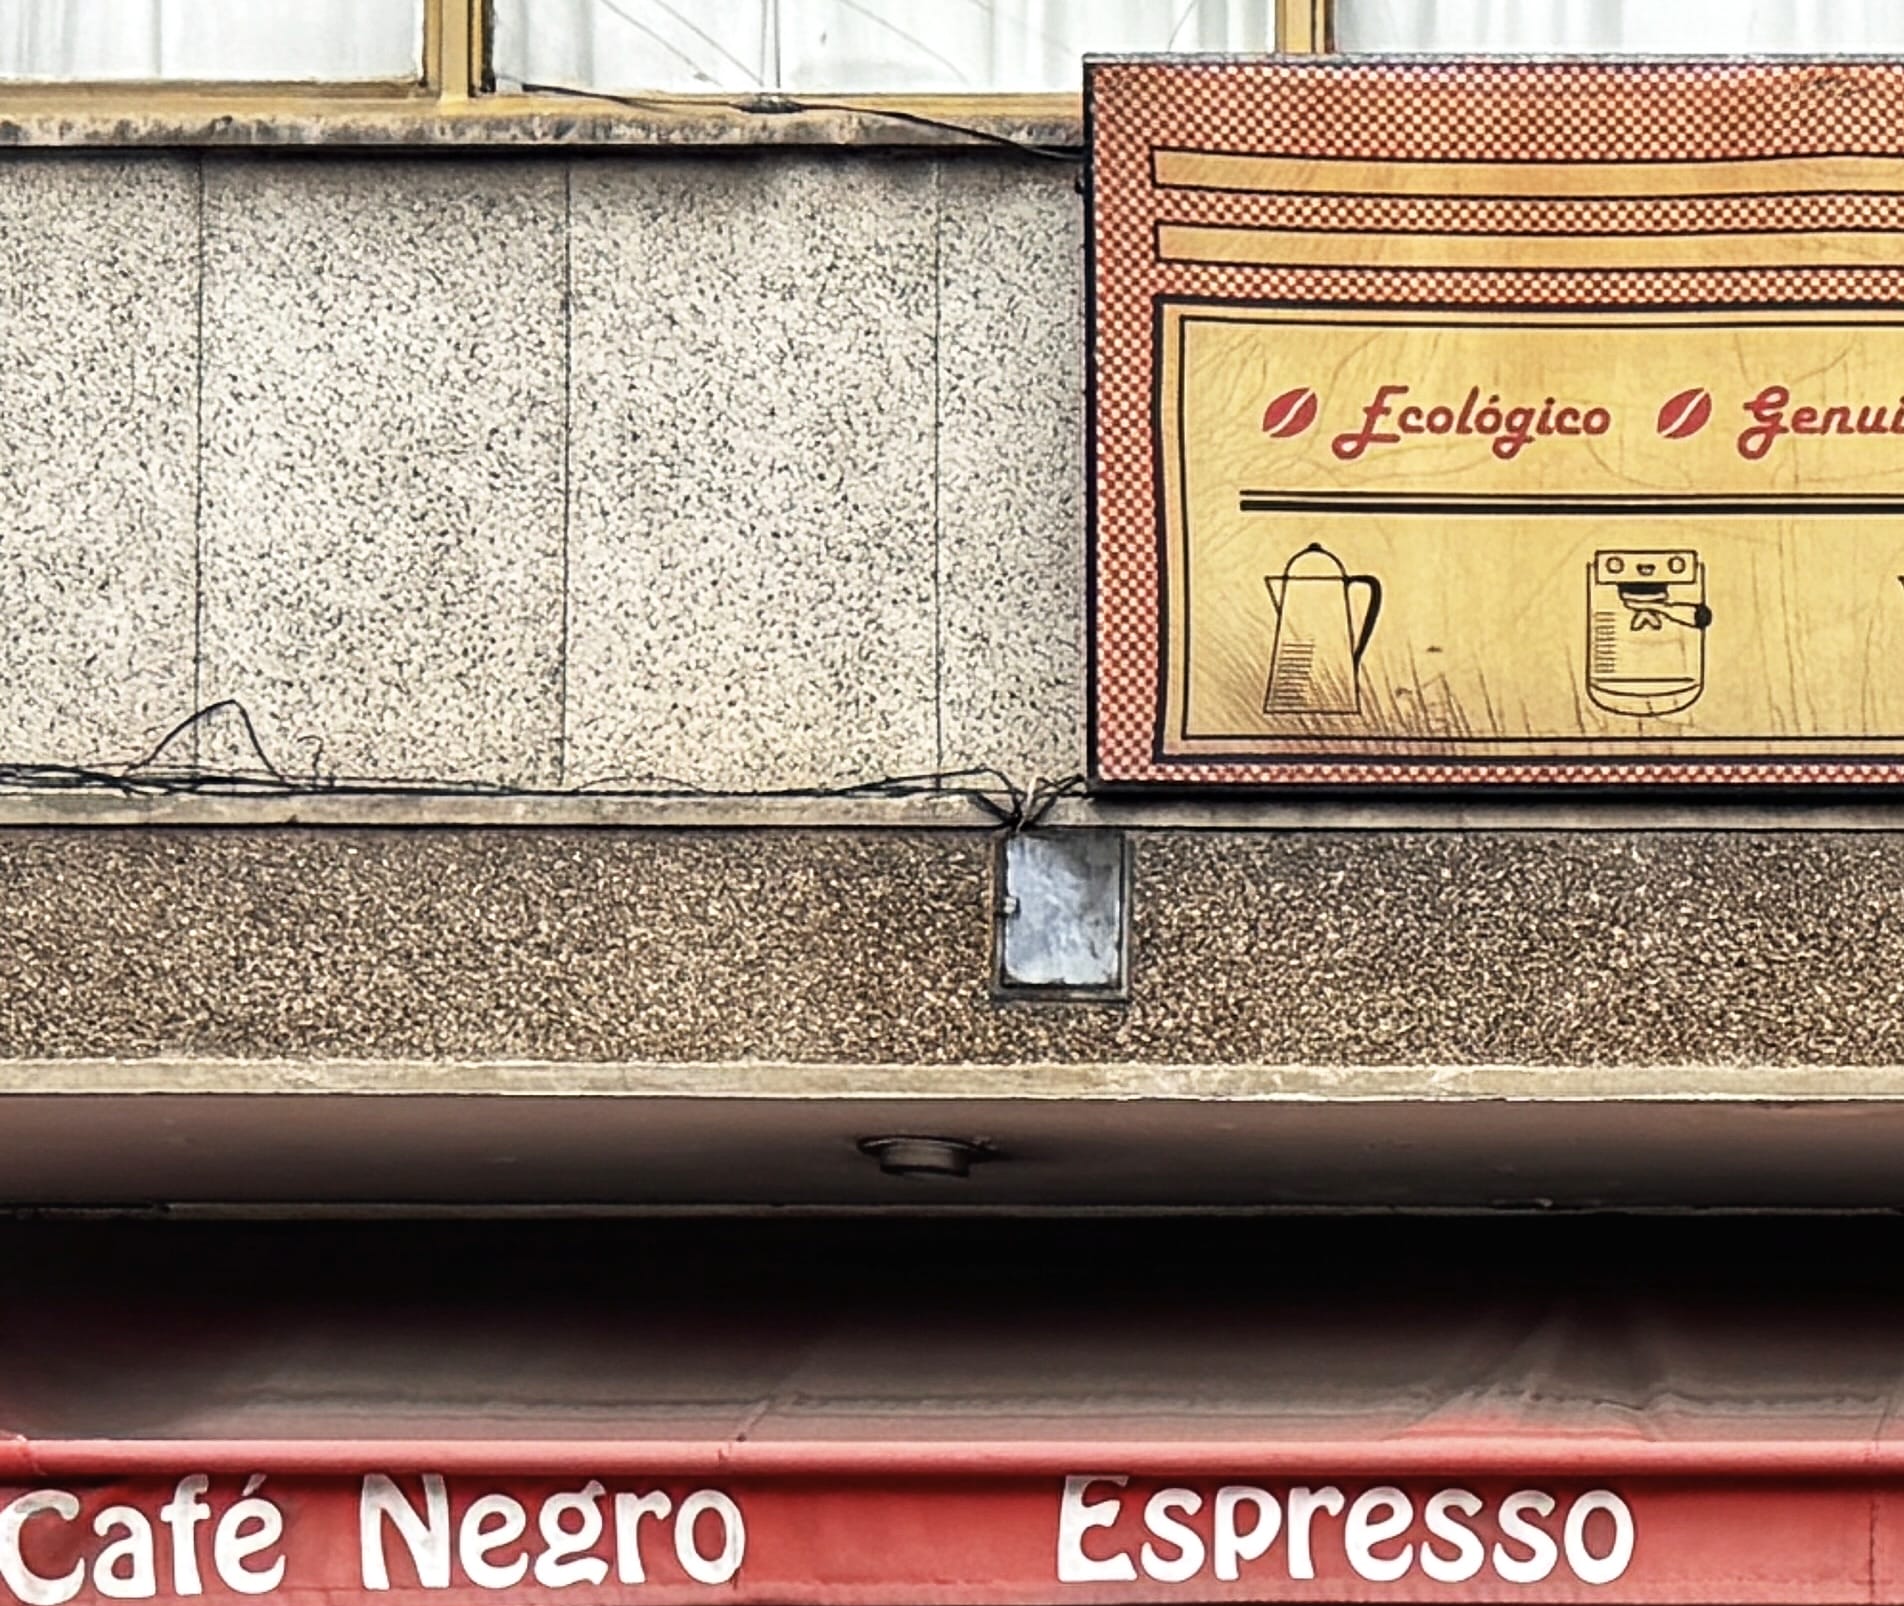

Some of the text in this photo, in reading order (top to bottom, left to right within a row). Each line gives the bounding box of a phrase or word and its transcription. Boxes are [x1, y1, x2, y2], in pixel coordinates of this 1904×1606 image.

[1330, 385, 1613, 461] Ecológico
[0, 1472, 746, 1606] Café Negro
[1056, 1473, 1637, 1585] Espresso
